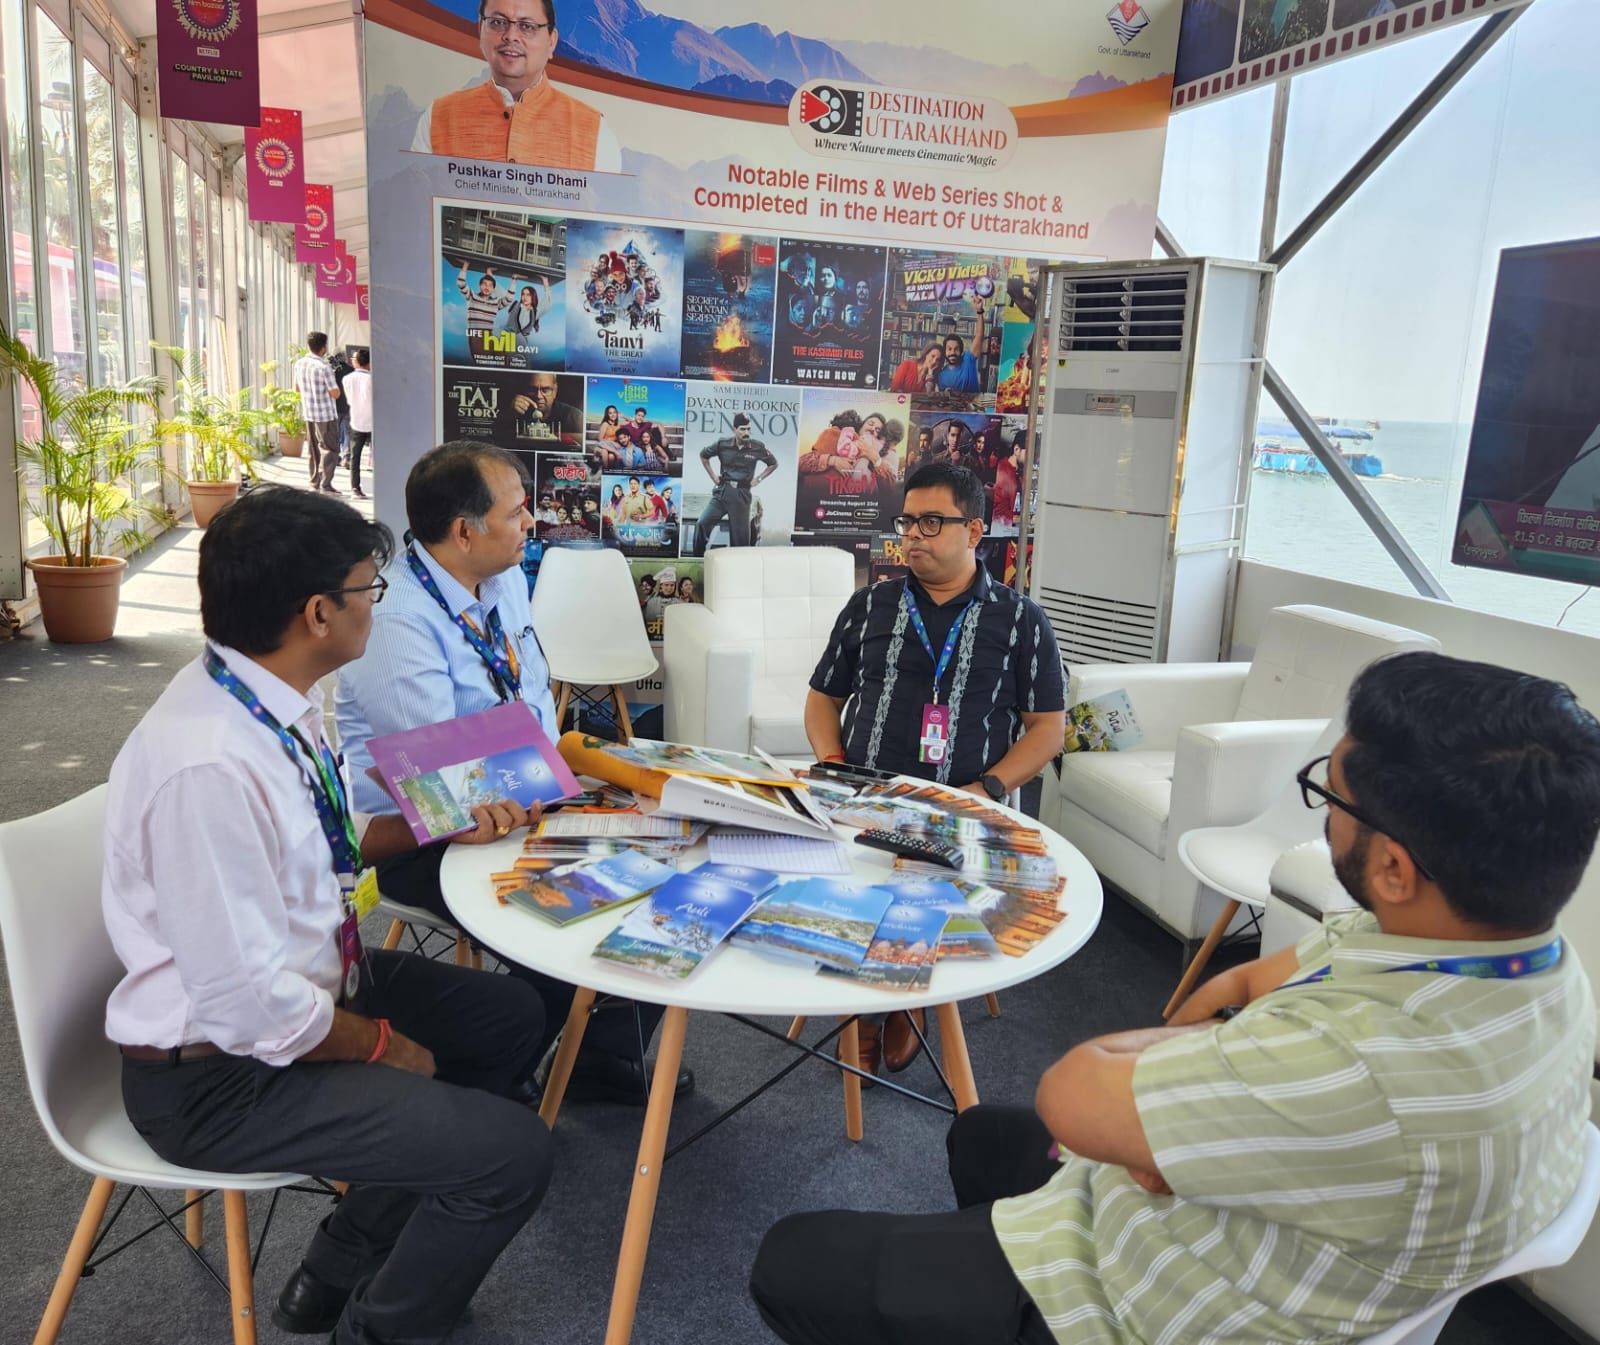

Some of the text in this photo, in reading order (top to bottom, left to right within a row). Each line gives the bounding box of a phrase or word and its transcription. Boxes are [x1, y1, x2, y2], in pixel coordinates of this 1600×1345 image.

[175, 63, 211, 73] COUNTRY
[220, 69, 242, 77] STATE
[192, 72, 227, 82] PAVILION
[869, 91, 985, 121] DESTINATION
[866, 112, 1007, 150] UTTARAKHAND
[814, 138, 997, 168] Where Nature meets Cinematic Magic
[448, 163, 587, 188] Pushkar Singh Dhami
[454, 179, 580, 200] Chief Minister, Uttarakhand
[728, 164, 1063, 213] Notable Films & Web Series Shot &
[694, 187, 1089, 240] Completed in the Heart Of Uttarakhand
[686, 295, 719, 305] SECRET
[686, 304, 729, 314] MOUNTAIN
[466, 329, 483, 337] LIFE
[597, 329, 644, 350] Tanvi
[605, 349, 620, 357] THE
[792, 346, 864, 359] THE KASHMIR FILES
[797, 368, 857, 381] WATCH NOW
[453, 385, 500, 410] TAJ
[713, 386, 732, 395] SAM
[458, 407, 500, 418] STORY
[1537, 534, 1553, 546] Cr.
[497, 769, 523, 790] Auli
[675, 902, 712, 917] Auli
